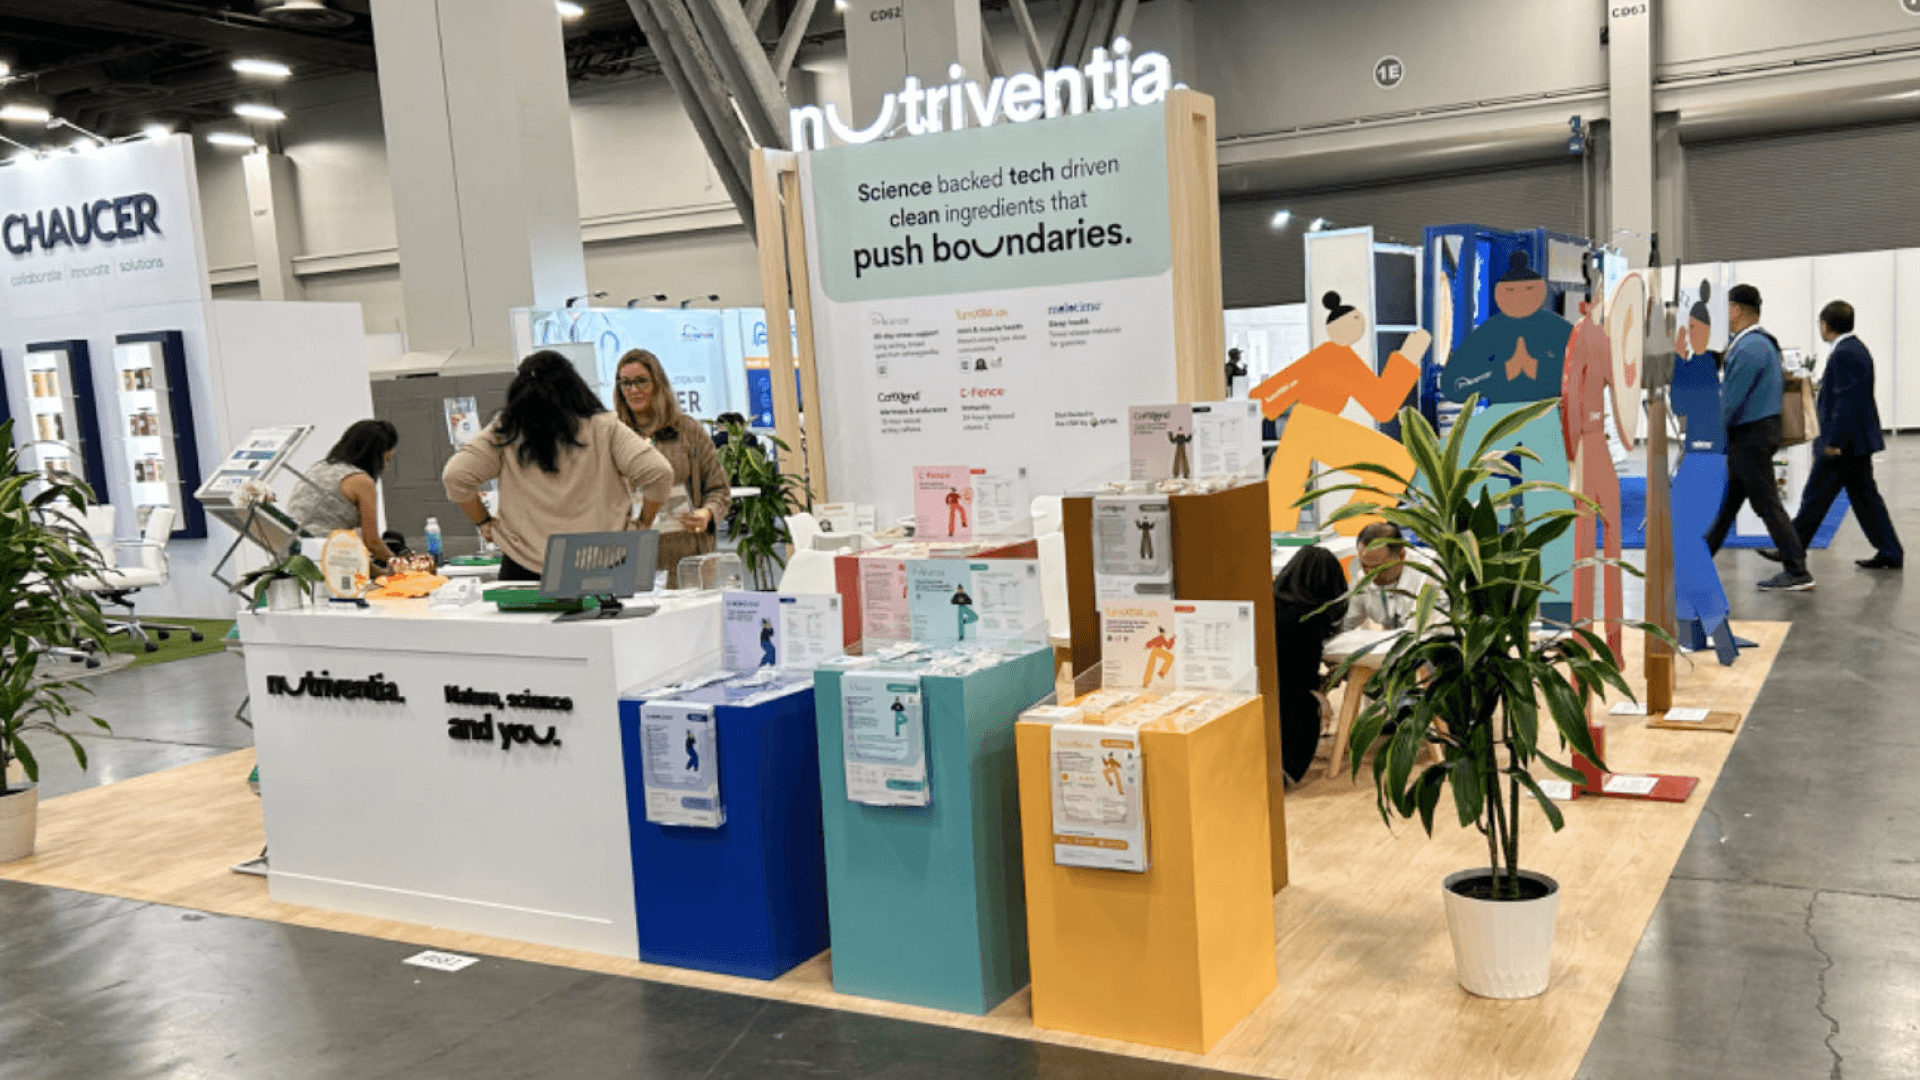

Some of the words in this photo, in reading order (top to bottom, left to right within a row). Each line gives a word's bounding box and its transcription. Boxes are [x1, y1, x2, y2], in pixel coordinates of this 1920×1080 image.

[1377, 64, 1400, 81] 1E
[857, 179, 933, 203] Science
[936, 170, 1004, 195] backed
[1008, 161, 1054, 186] tech
[1060, 154, 1120, 179] driven
[2, 191, 163, 255] CHAUCER
[888, 206, 941, 229] clean
[943, 197, 1046, 228] ingredients
[1050, 190, 1089, 213] that
[119, 256, 165, 274] solutions
[853, 232, 924, 279] push
[932, 218, 1134, 263] boundaries.
[447, 713, 494, 740] and
[497, 721, 562, 751] you.
